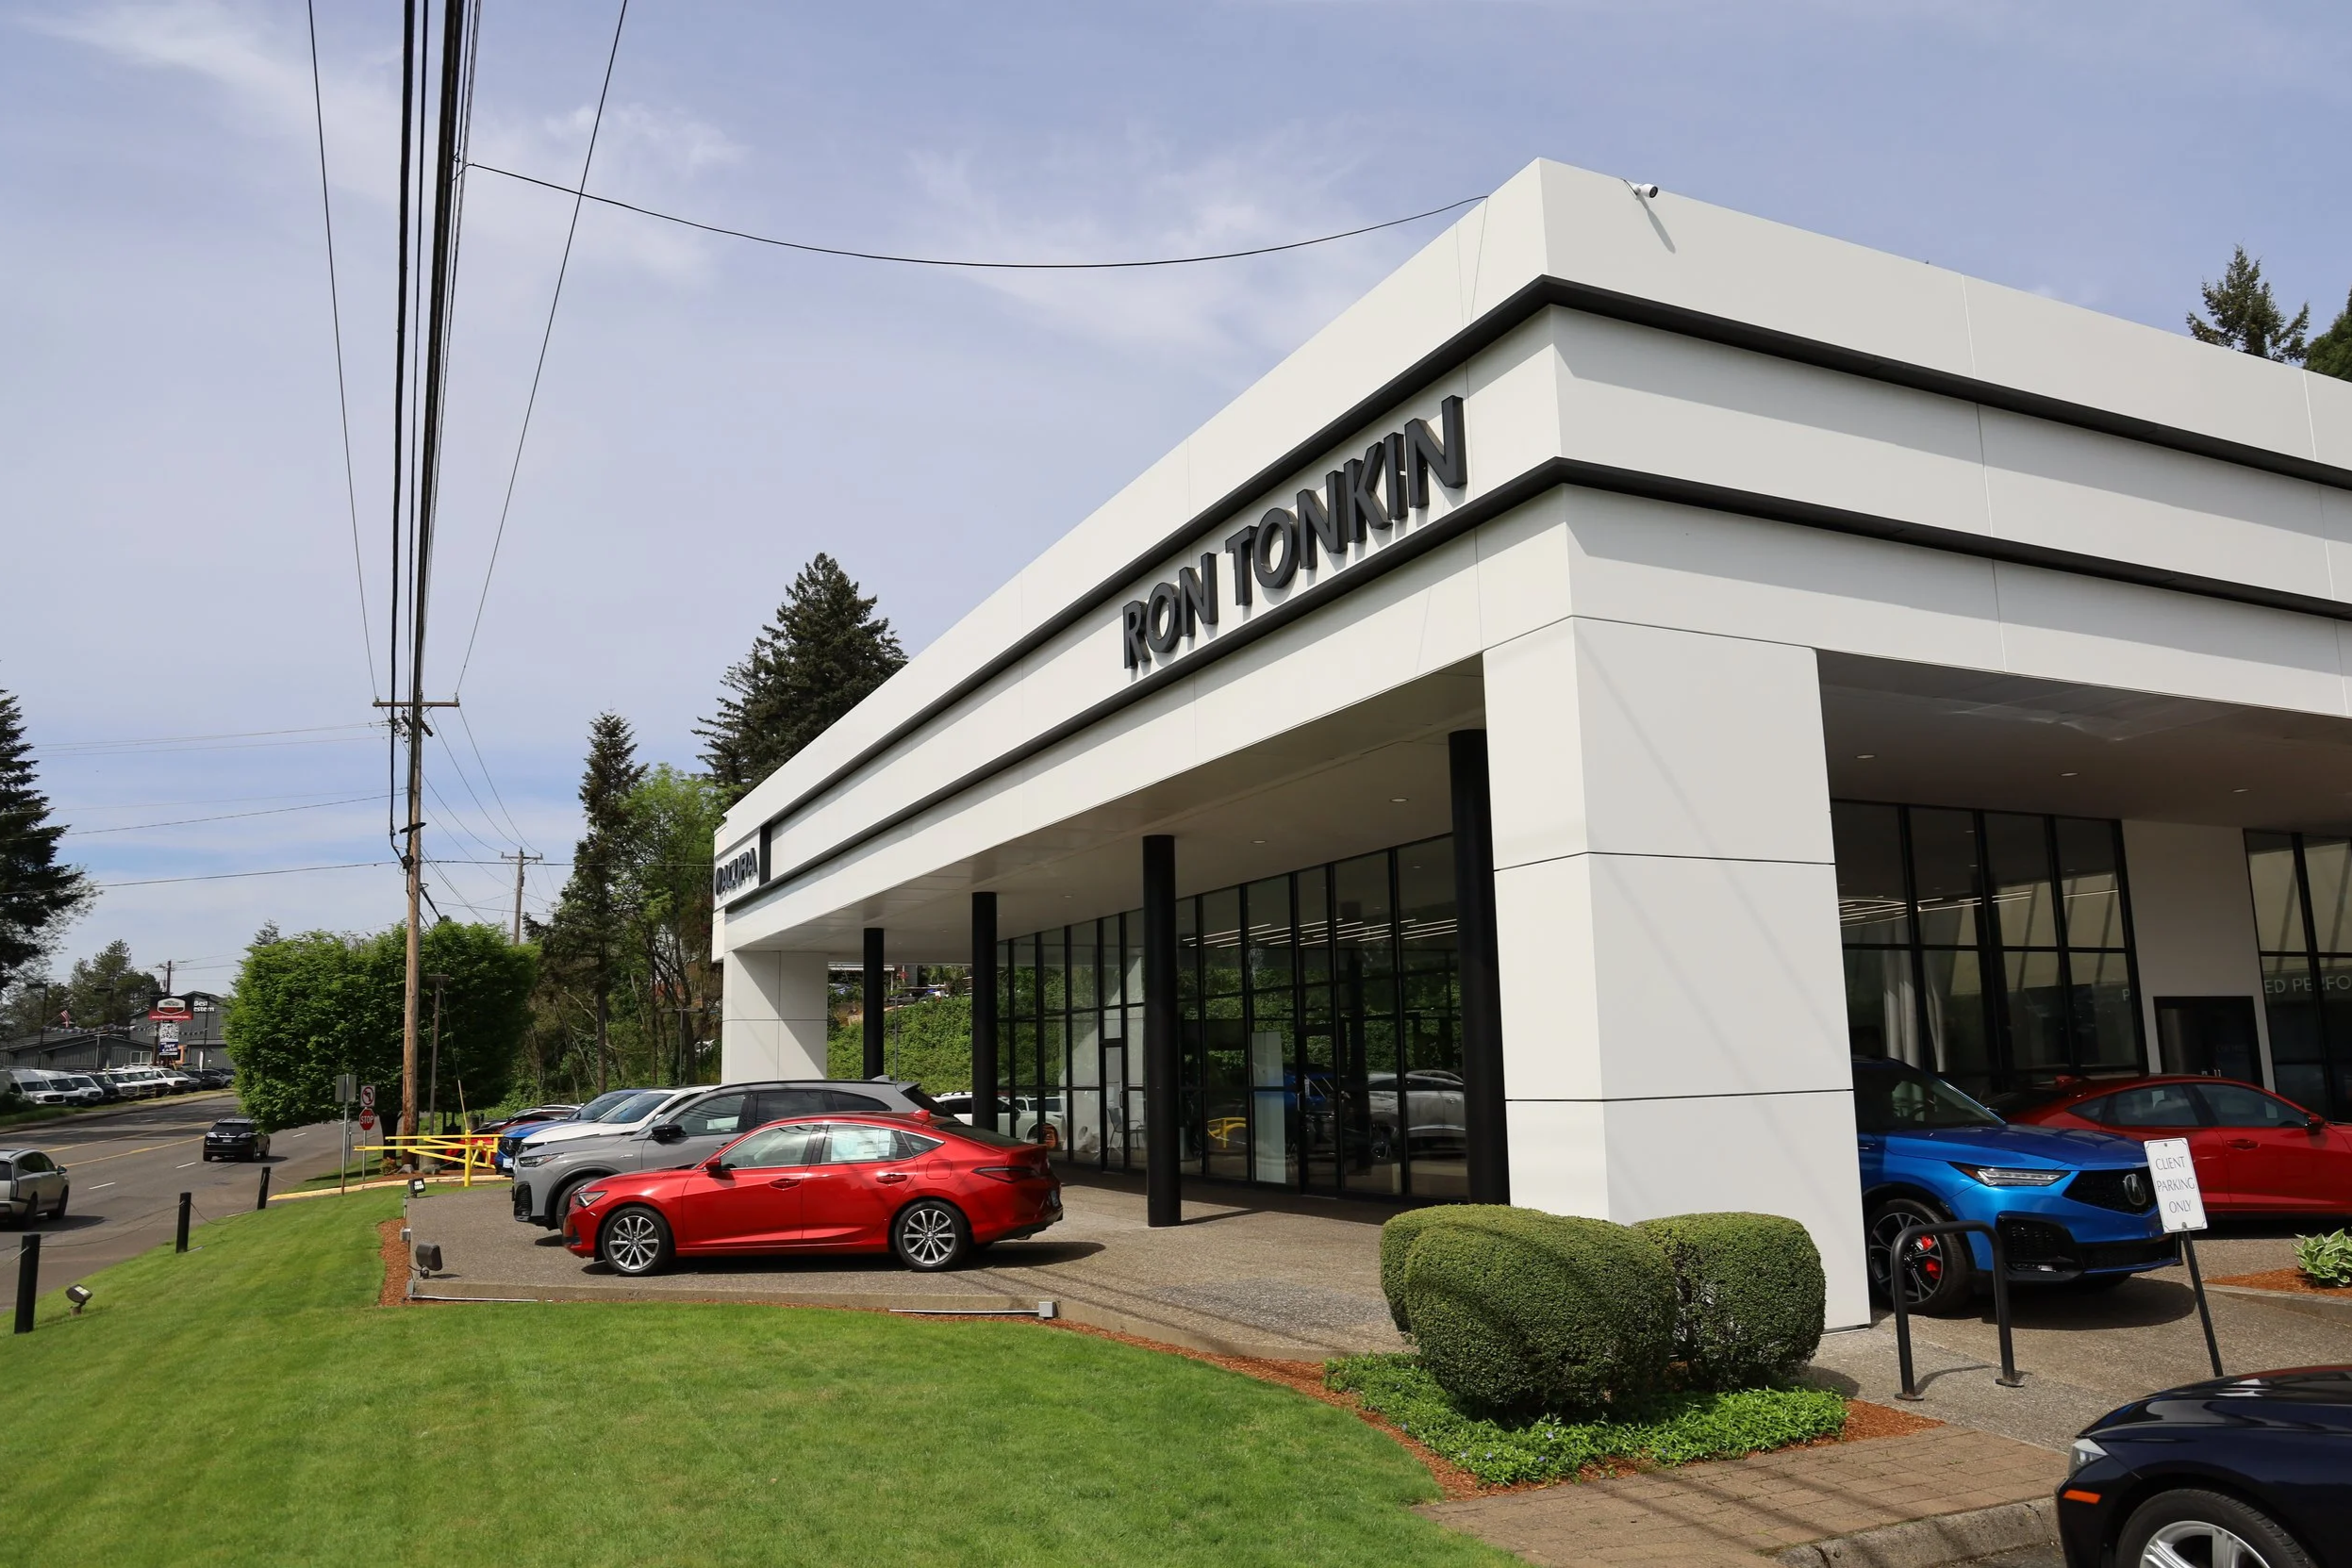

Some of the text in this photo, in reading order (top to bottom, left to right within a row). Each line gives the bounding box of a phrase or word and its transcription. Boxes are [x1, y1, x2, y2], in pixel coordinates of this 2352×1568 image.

[1122, 395, 1467, 668] RON TONKIN
[720, 848, 758, 893] ACURA
[2293, 975, 2352, 993] PEFO
[360, 1115, 373, 1124] STOP
[2155, 1156, 2185, 1170] CLIENT
[2156, 1177, 2195, 1192] PARKING
[2168, 1199, 2192, 1213] ONLY
